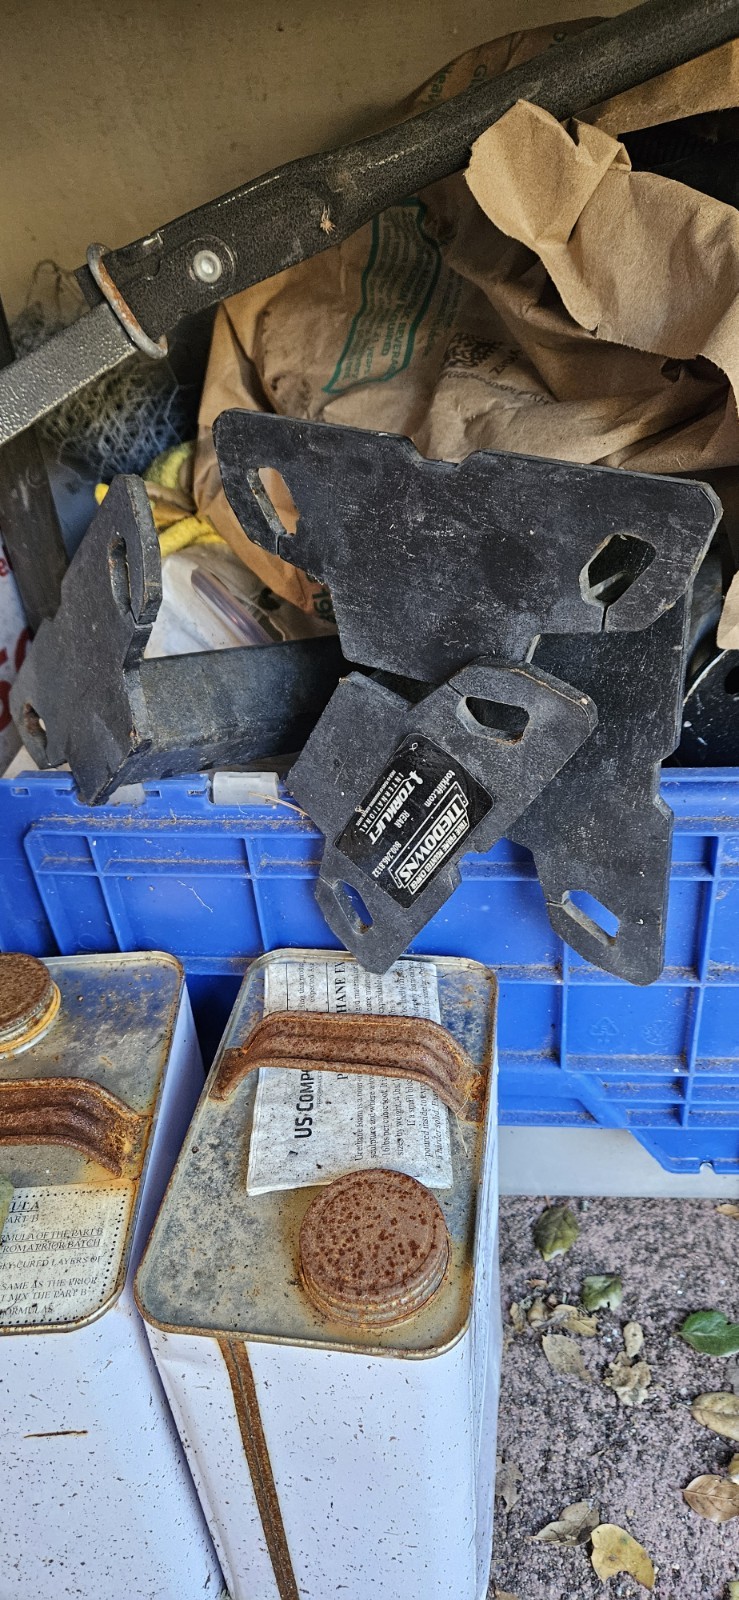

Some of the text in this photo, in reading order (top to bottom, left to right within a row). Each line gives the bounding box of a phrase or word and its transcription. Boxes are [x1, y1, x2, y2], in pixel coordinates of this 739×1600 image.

[423, 768, 455, 807] torklift.com
[358, 772, 403, 833] INTERNATIONAL
[367, 780, 415, 844] TORKLIFT
[393, 809, 410, 828] REAR
[454, 819, 468, 835] TRUE
[397, 802, 463, 882] TIEDOWNS
[440, 832, 457, 852] FRAME
[370, 840, 402, 878] 800.246.8132
[424, 848, 444, 872] MOUNTED
[294, 1116, 312, 1138] US
[354, 1128, 362, 1160] Urethane
[368, 1126, 376, 1158] sculpture
[421, 1130, 432, 1157] poured
[35, 1241, 65, 1251] PRIOR
[66, 1238, 101, 1248] BATCH
[50, 1229, 68, 1238] THE
[50, 1255, 88, 1266] LAYERS
[1, 1281, 29, 1291] SAME
